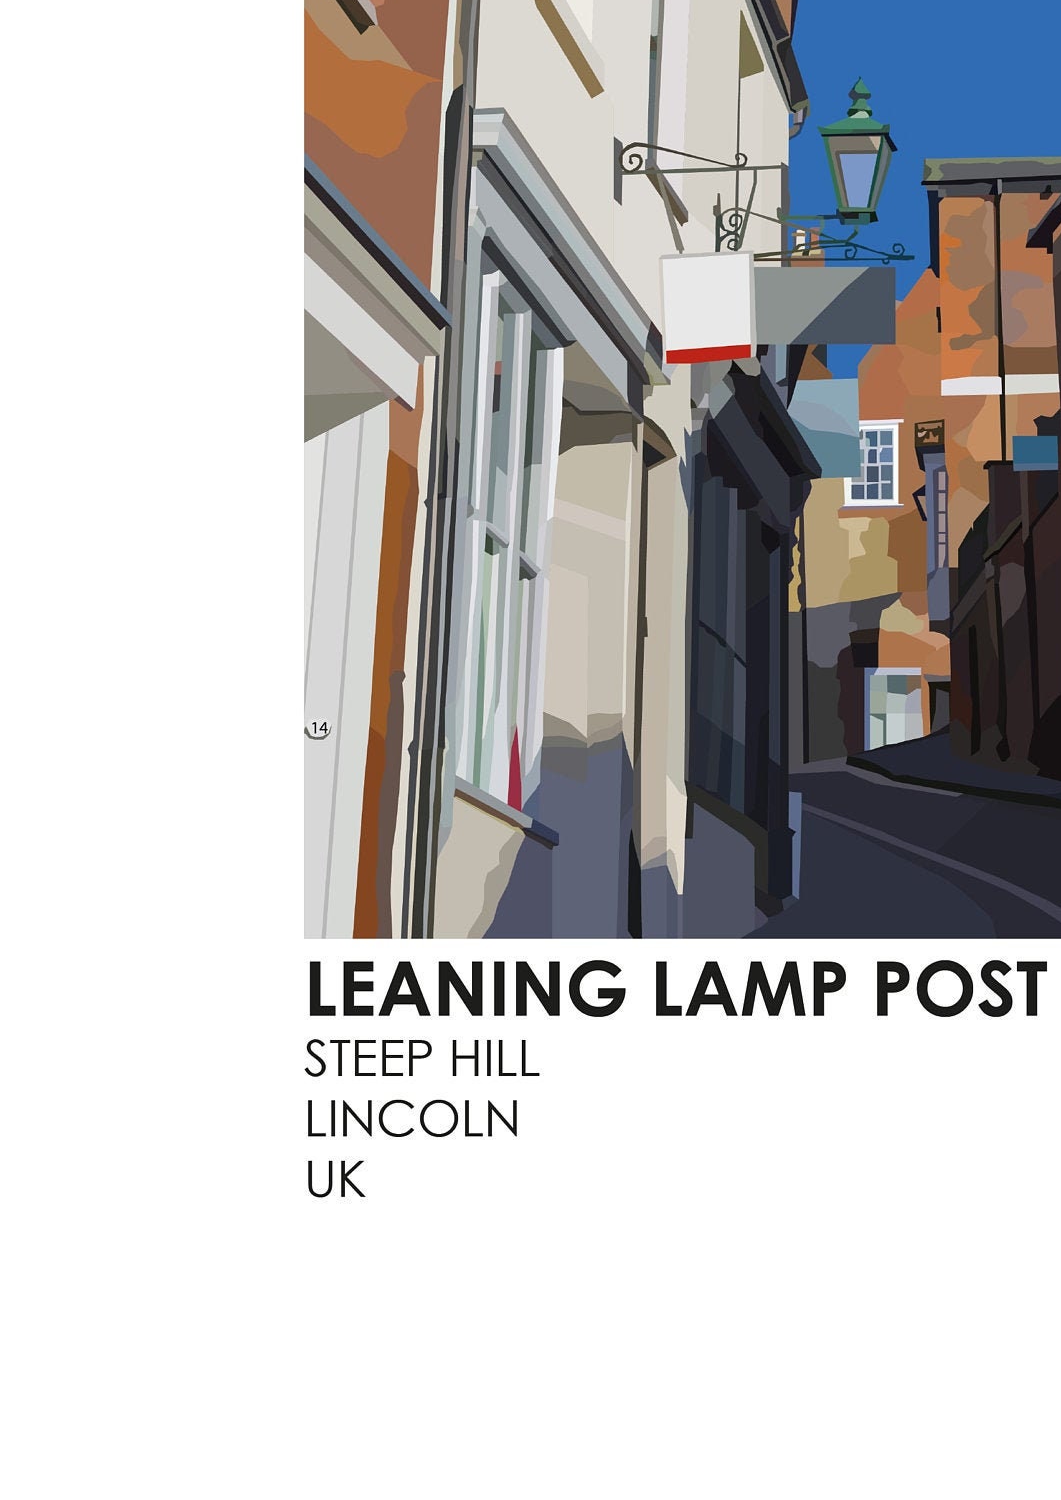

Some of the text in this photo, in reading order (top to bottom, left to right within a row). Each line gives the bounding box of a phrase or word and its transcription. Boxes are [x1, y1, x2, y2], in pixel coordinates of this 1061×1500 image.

[311, 721, 328, 734] 14
[309, 959, 1048, 1018] LEANING LAMP POST
[304, 1038, 540, 1078] STEEP HILL
[307, 1099, 518, 1138] LINCOLN
[307, 1160, 366, 1198] UK
